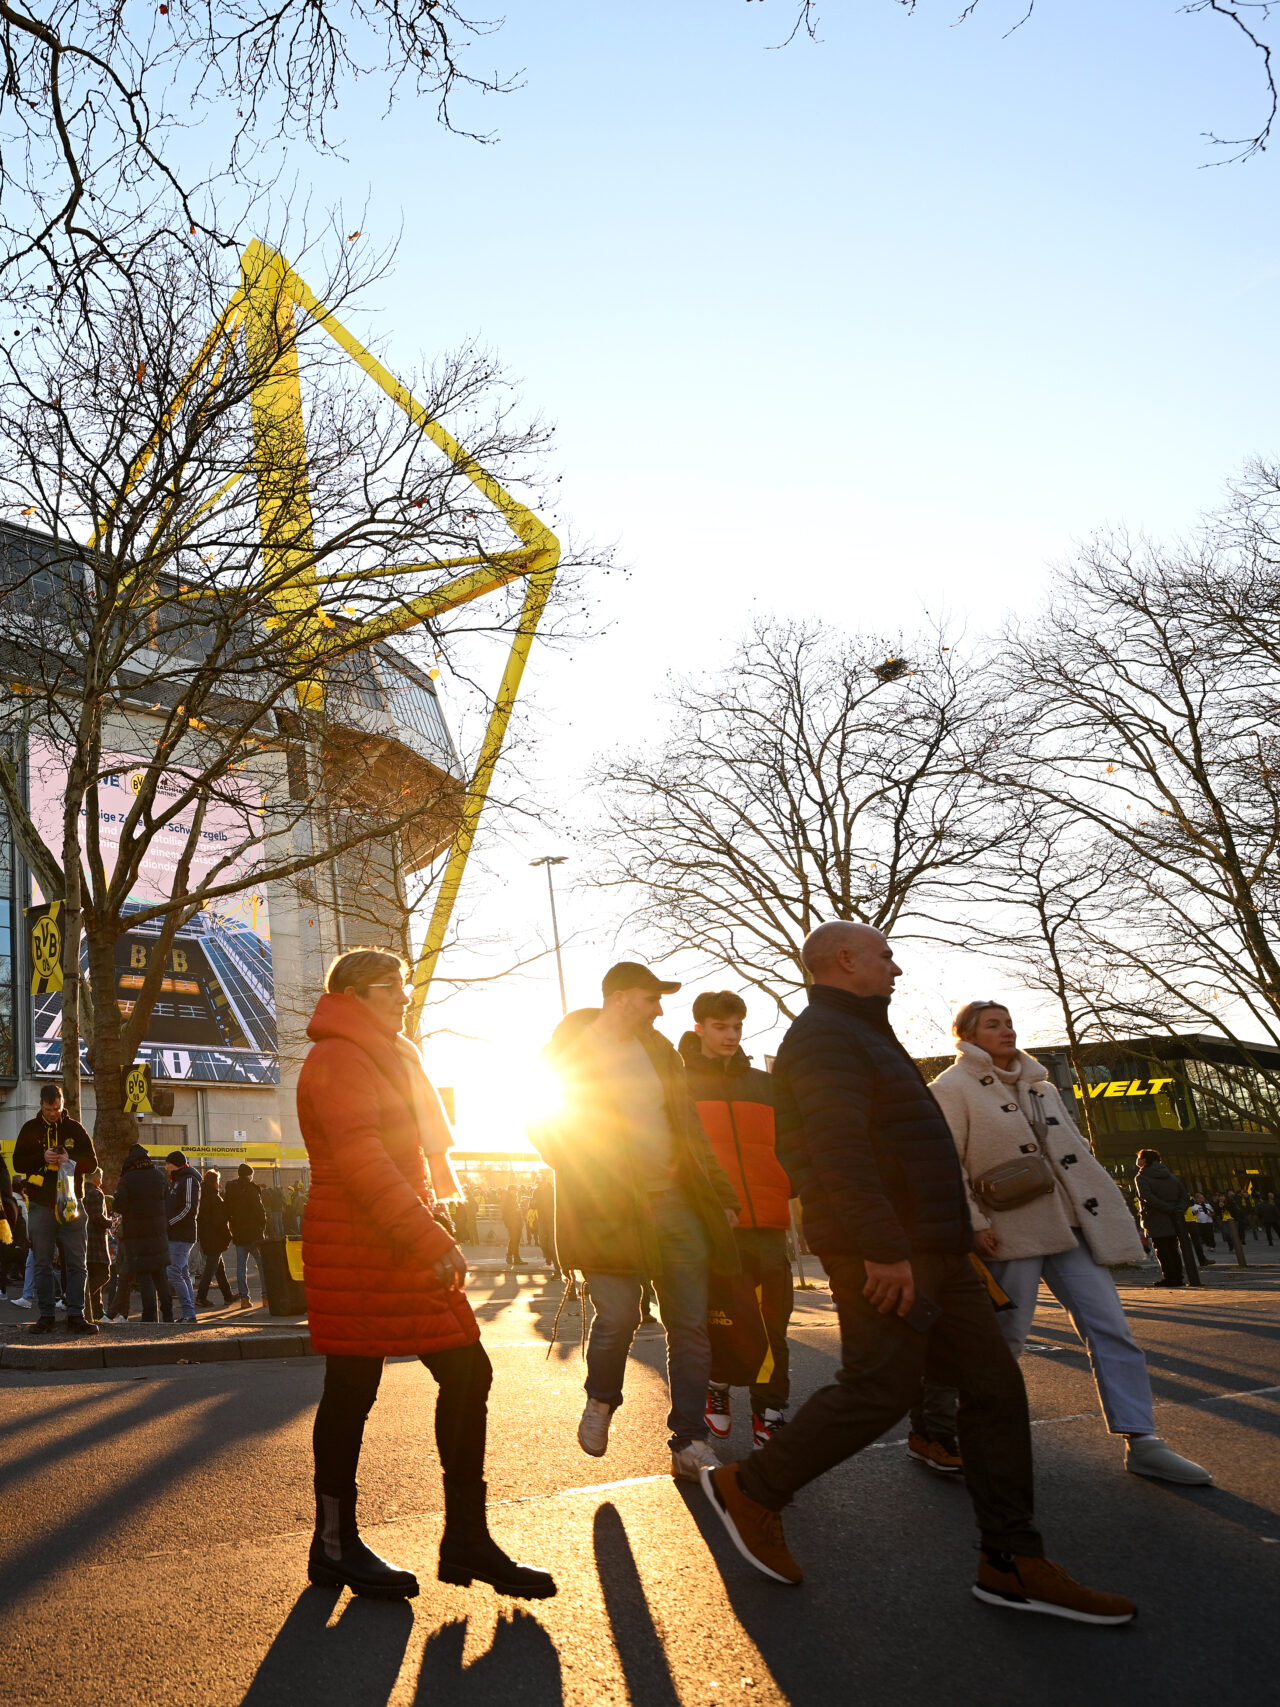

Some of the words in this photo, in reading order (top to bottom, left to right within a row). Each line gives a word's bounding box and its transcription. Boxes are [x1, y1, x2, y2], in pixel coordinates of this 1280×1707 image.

[169, 823, 228, 842] Schwrzgelb
[35, 922, 57, 960] BVB
[131, 944, 189, 973] BB
[128, 1074, 145, 1094] BVB
[1072, 1078, 1174, 1100] WELT
